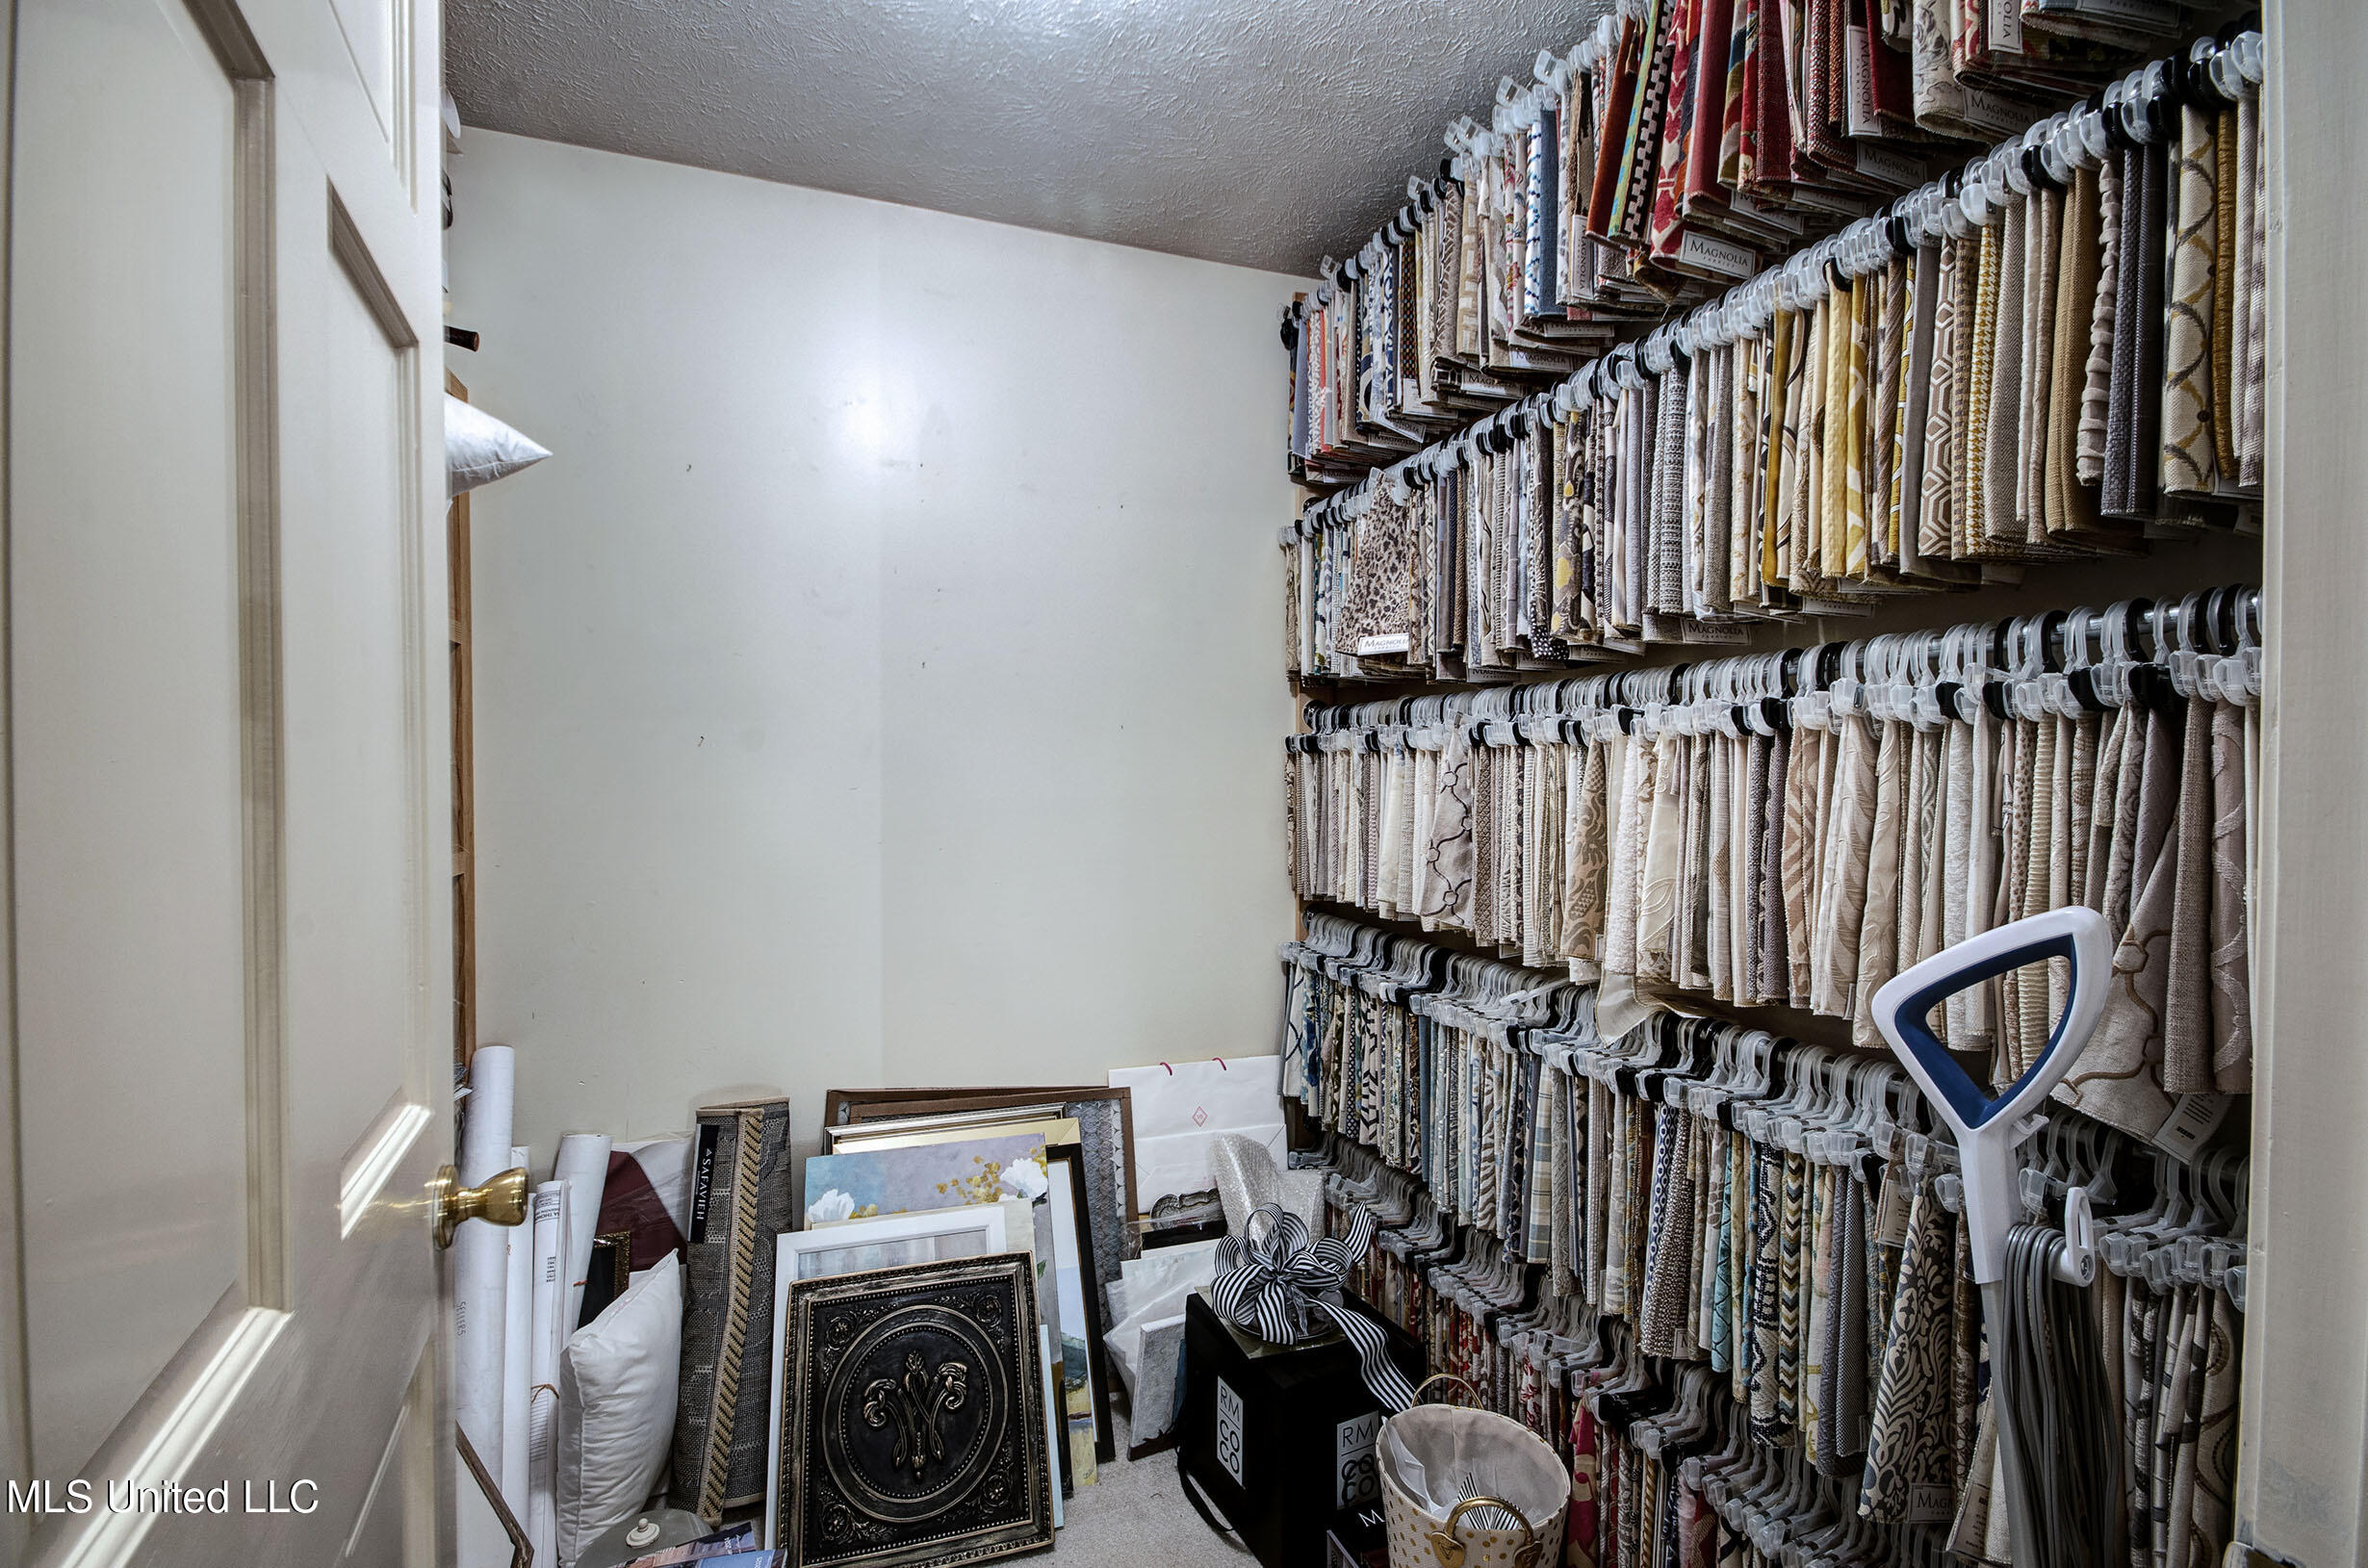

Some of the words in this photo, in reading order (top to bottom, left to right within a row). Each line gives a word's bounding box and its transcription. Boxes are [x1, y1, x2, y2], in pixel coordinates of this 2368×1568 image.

[2002, 1, 2013, 39] OLIA
[1861, 39, 1870, 124] MAGNOLIA
[1970, 94, 2031, 125] MAGNOLIA
[1689, 240, 1748, 267] MAGNOLIA
[1688, 622, 1743, 635] MAGNOLIA
[696, 1158, 711, 1221] SAFAVIEH
[1221, 1386, 1240, 1423] RM
[1220, 1419, 1240, 1452] CO
[1343, 1419, 1374, 1448] RM
[1220, 1440, 1240, 1474] CO
